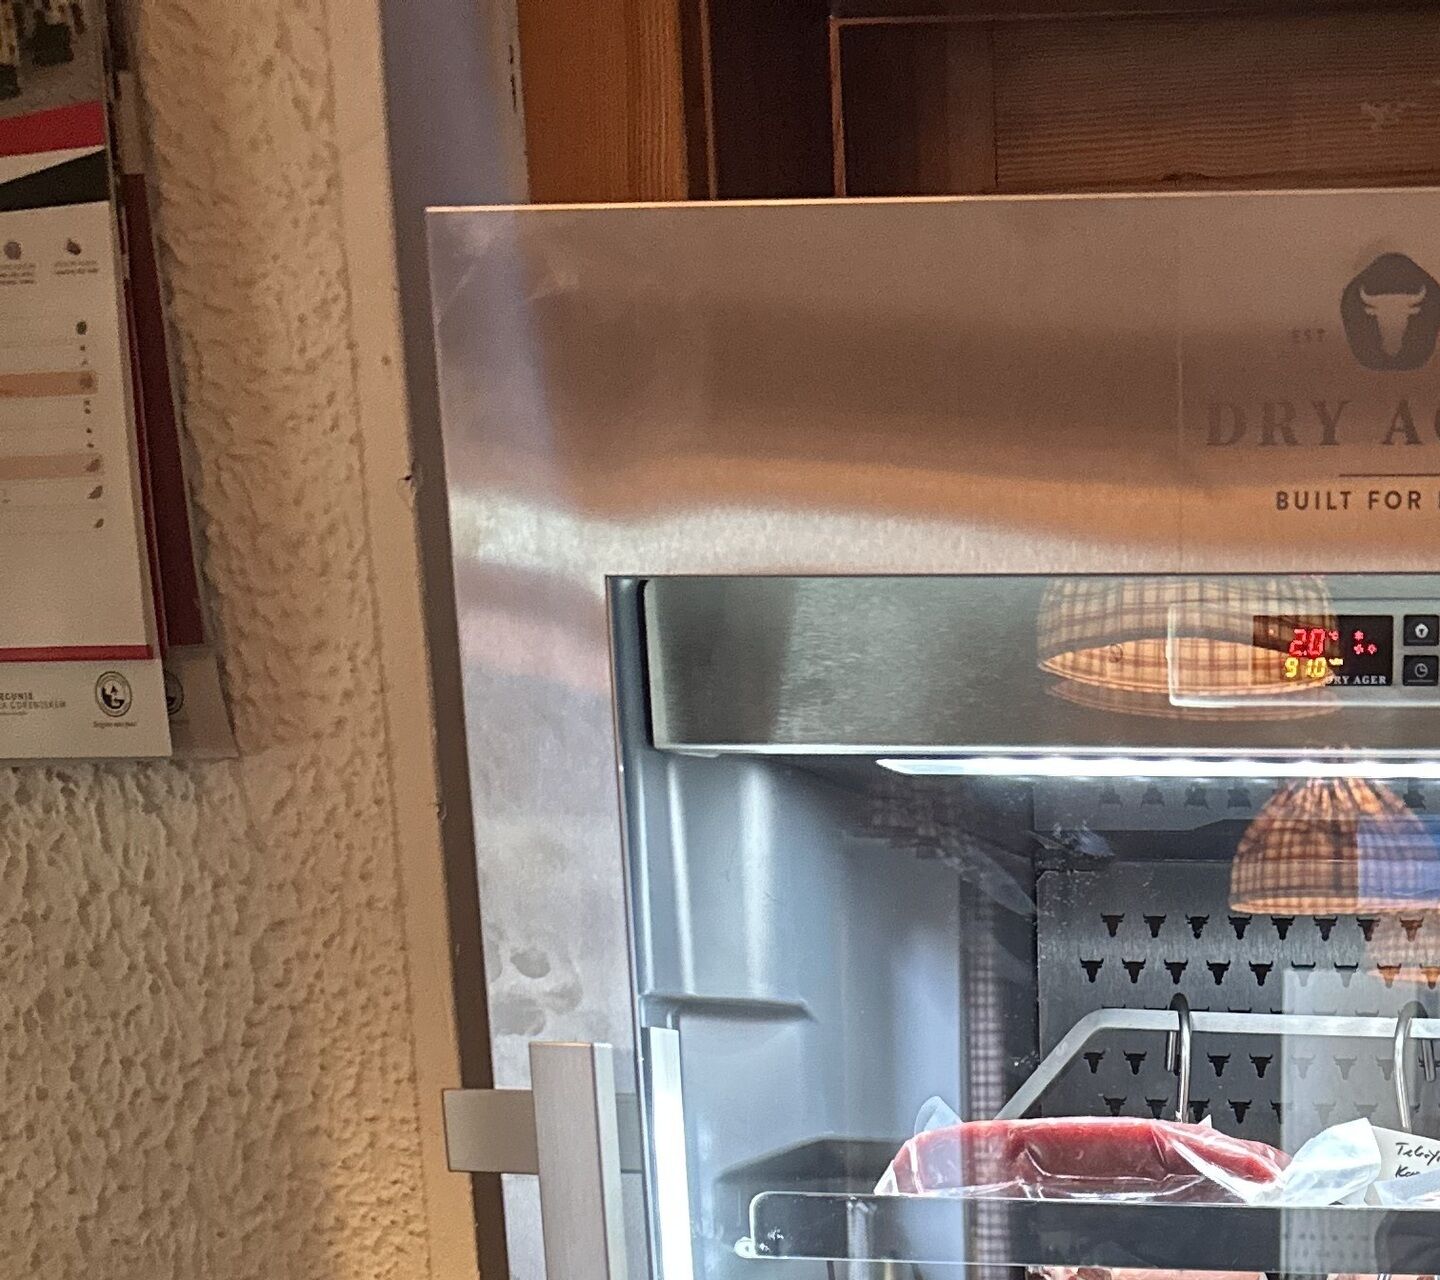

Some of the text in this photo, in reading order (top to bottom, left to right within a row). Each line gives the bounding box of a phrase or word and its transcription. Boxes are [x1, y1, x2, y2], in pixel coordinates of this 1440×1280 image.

[1207, 399, 1347, 447] DRY
[1275, 491, 1352, 511] BUILT
[1368, 490, 1422, 510] FOR
[1353, 675, 1387, 685] AGER
